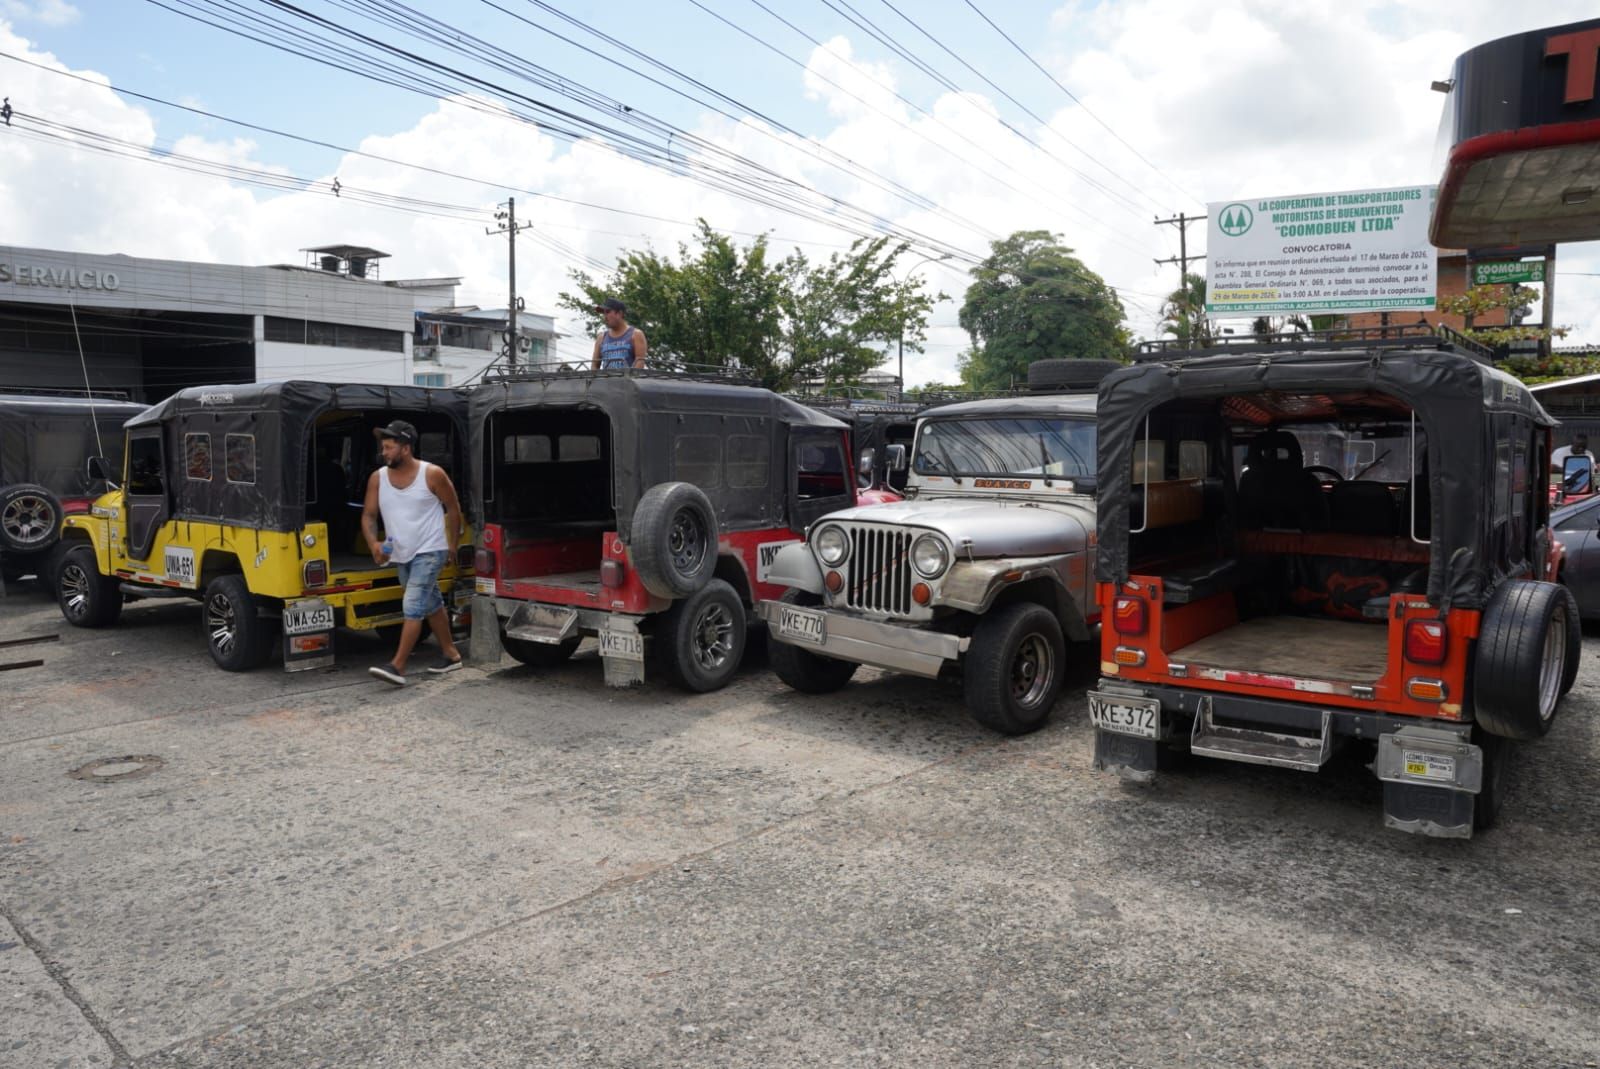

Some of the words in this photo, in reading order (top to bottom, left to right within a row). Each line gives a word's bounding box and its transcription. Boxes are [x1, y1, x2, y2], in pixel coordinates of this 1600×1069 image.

[1258, 202, 1268, 212] LA
[1270, 197, 1324, 211] COOPERATIVA
[1326, 196, 1336, 206] DE
[1338, 189, 1422, 205] TRANSPORTADORES
[1272, 210, 1324, 224] MOTORISTAS
[1326, 209, 1336, 220] DE
[1338, 204, 1404, 218] BUENAVENTURA
[1282, 243, 1351, 254] CONVOCATORIA
[1291, 256, 1318, 264] ordinaria
[0, 263, 120, 291] SERVICIO
[1263, 268, 1286, 278] Consejo
[1300, 266, 1345, 274] Administración
